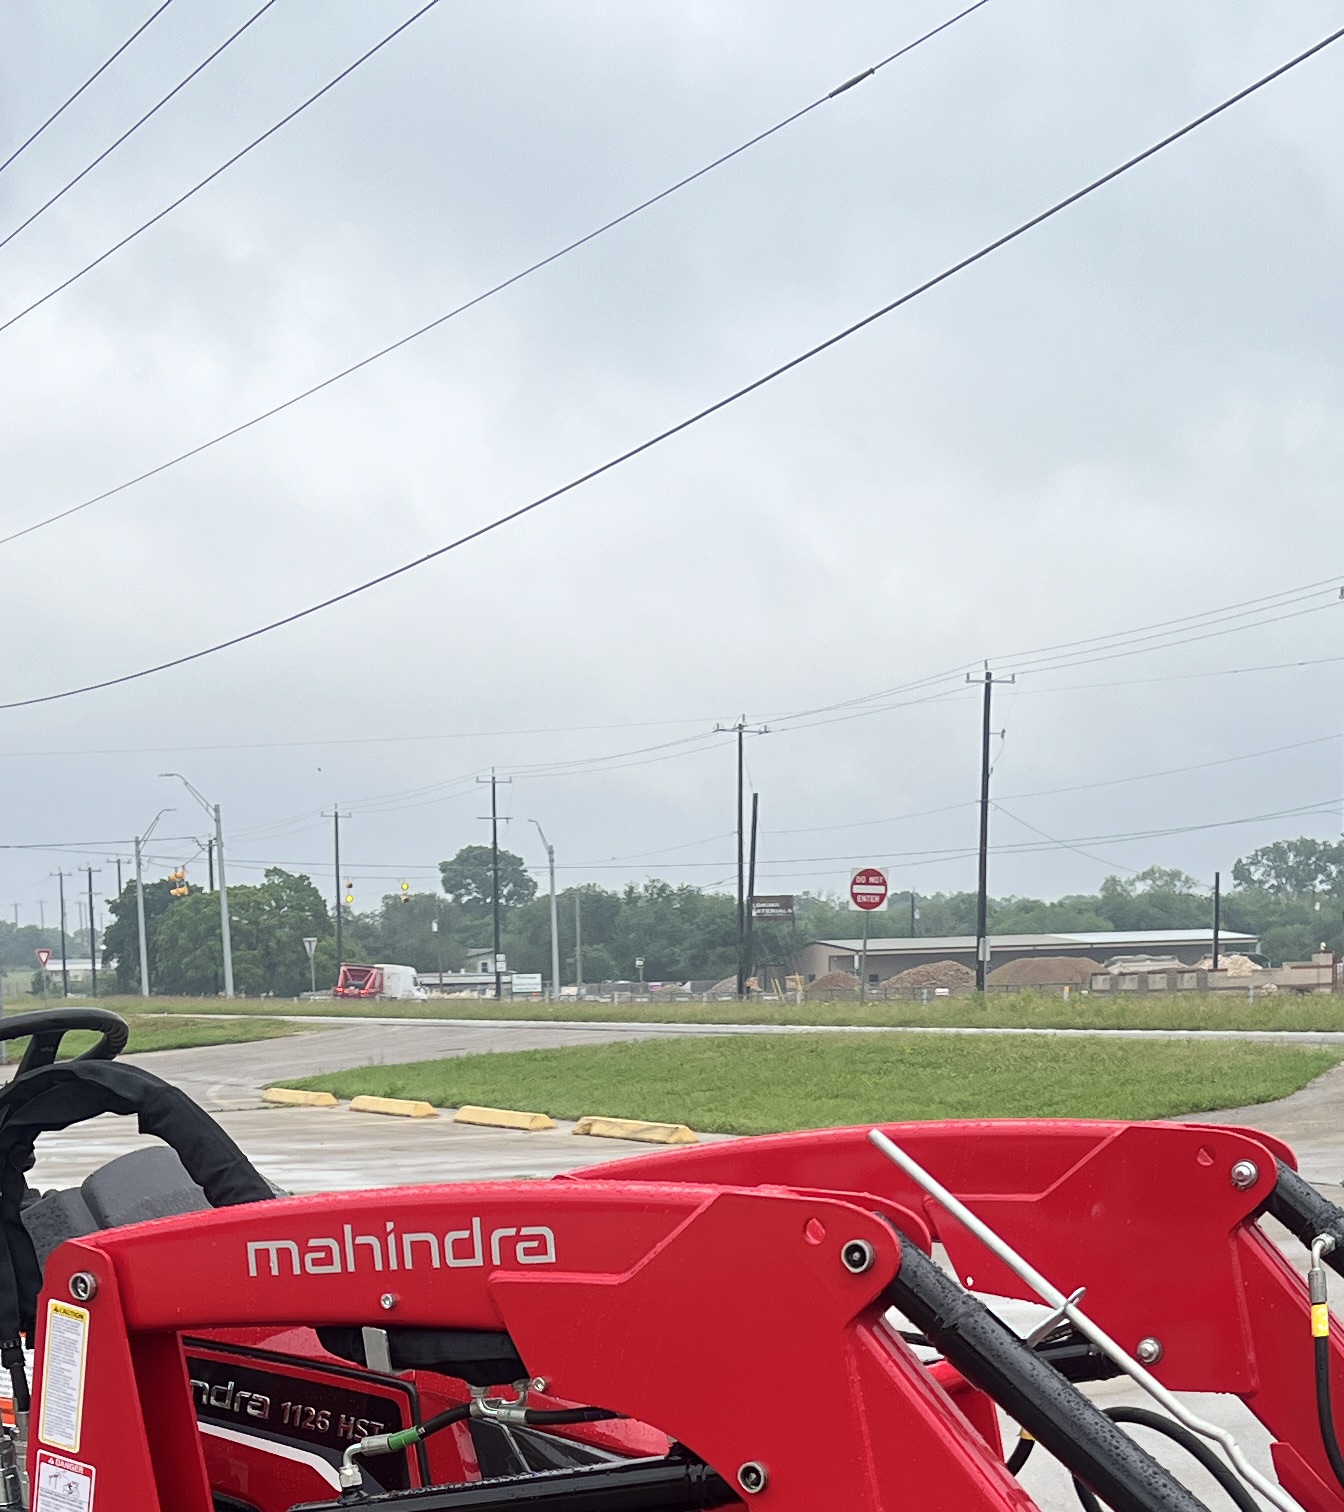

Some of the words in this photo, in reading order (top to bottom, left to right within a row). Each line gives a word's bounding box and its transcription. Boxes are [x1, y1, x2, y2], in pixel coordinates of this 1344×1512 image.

[855, 875, 866, 884] DO
[868, 876, 884, 884] NOT
[856, 894, 880, 903] ENTER
[247, 1217, 556, 1277] mahindra
[281, 1400, 332, 1433] 1126
[54, 1459, 85, 1475] DANGER
